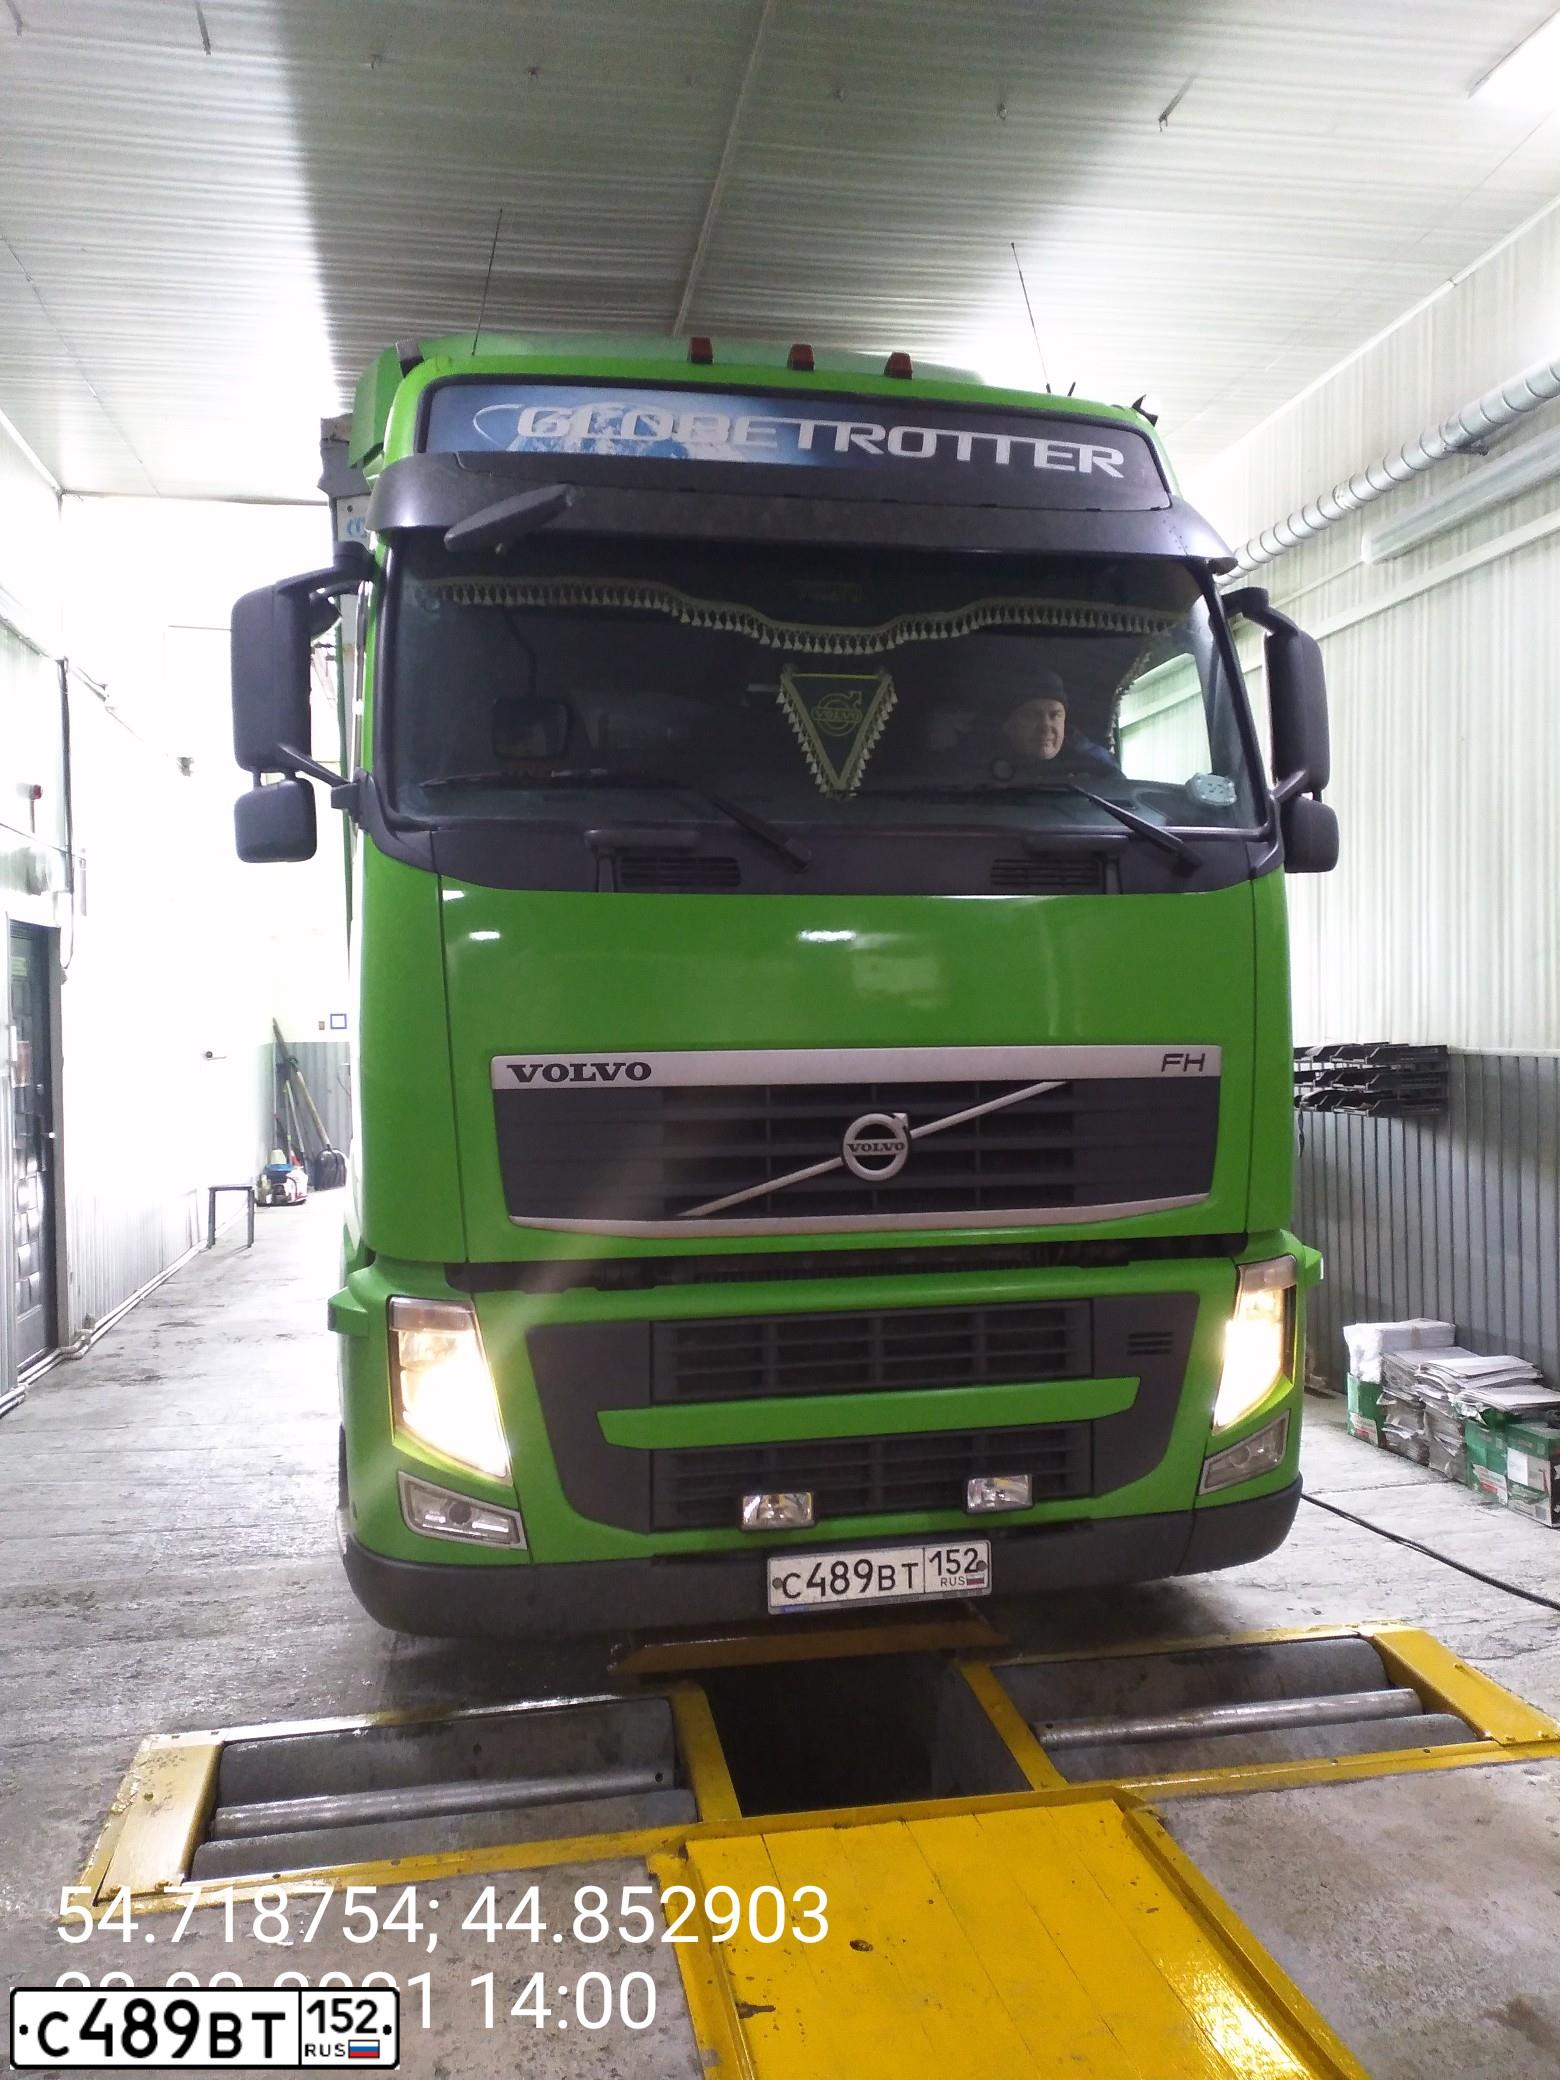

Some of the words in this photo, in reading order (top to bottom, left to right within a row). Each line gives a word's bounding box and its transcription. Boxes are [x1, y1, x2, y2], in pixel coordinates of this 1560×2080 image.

[516, 404, 1125, 479] GLOBETROTTER
[505, 1060, 653, 1084] VOLVO
[1161, 1051, 1206, 1073] FH
[846, 1141, 906, 1155] VOLVO
[928, 1547, 979, 1576] 152
[940, 1575, 966, 1588] RUS
